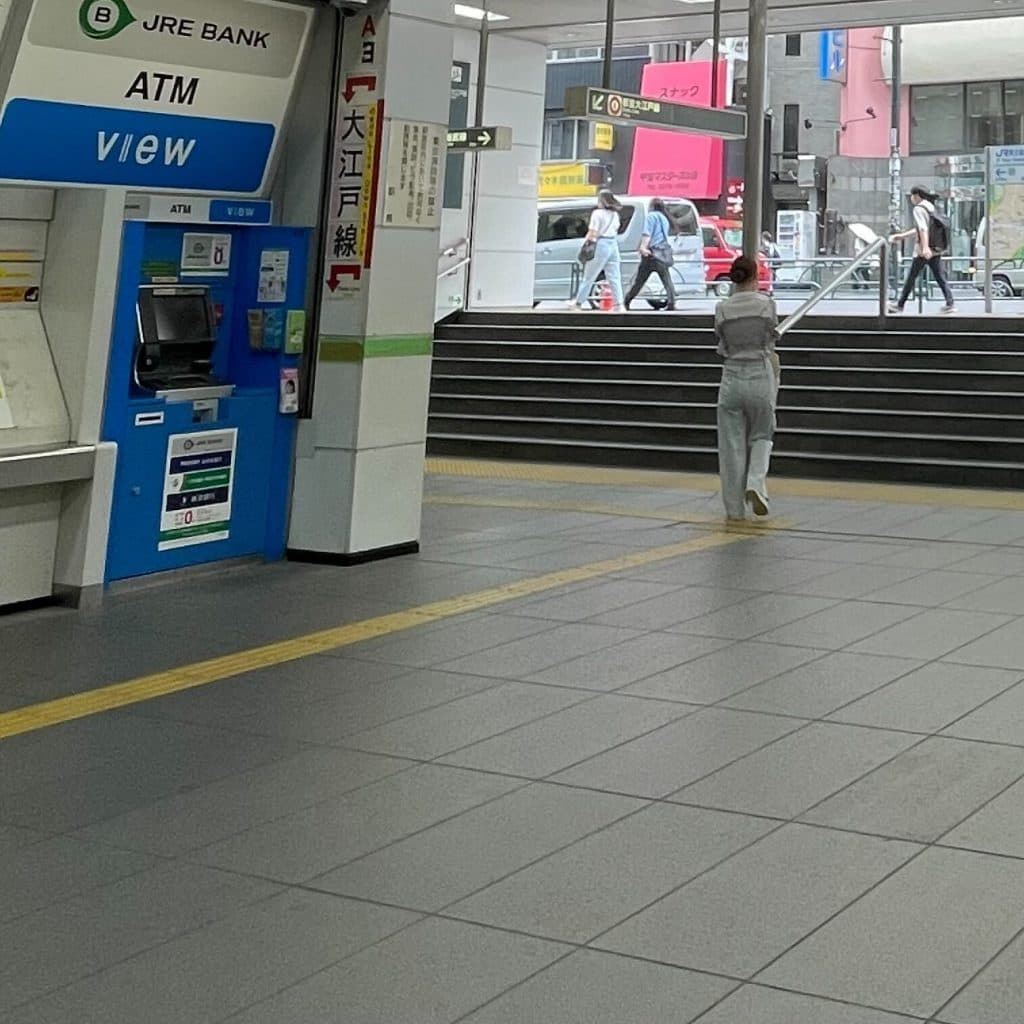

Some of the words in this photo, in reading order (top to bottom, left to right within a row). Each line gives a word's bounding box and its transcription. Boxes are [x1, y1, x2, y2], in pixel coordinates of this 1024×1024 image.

[143, 14, 196, 37] JRE
[201, 22, 271, 49] BANK
[124, 70, 200, 106] ATM
[334, 108, 365, 259] 大江戸線
[170, 204, 192, 215] ATM
